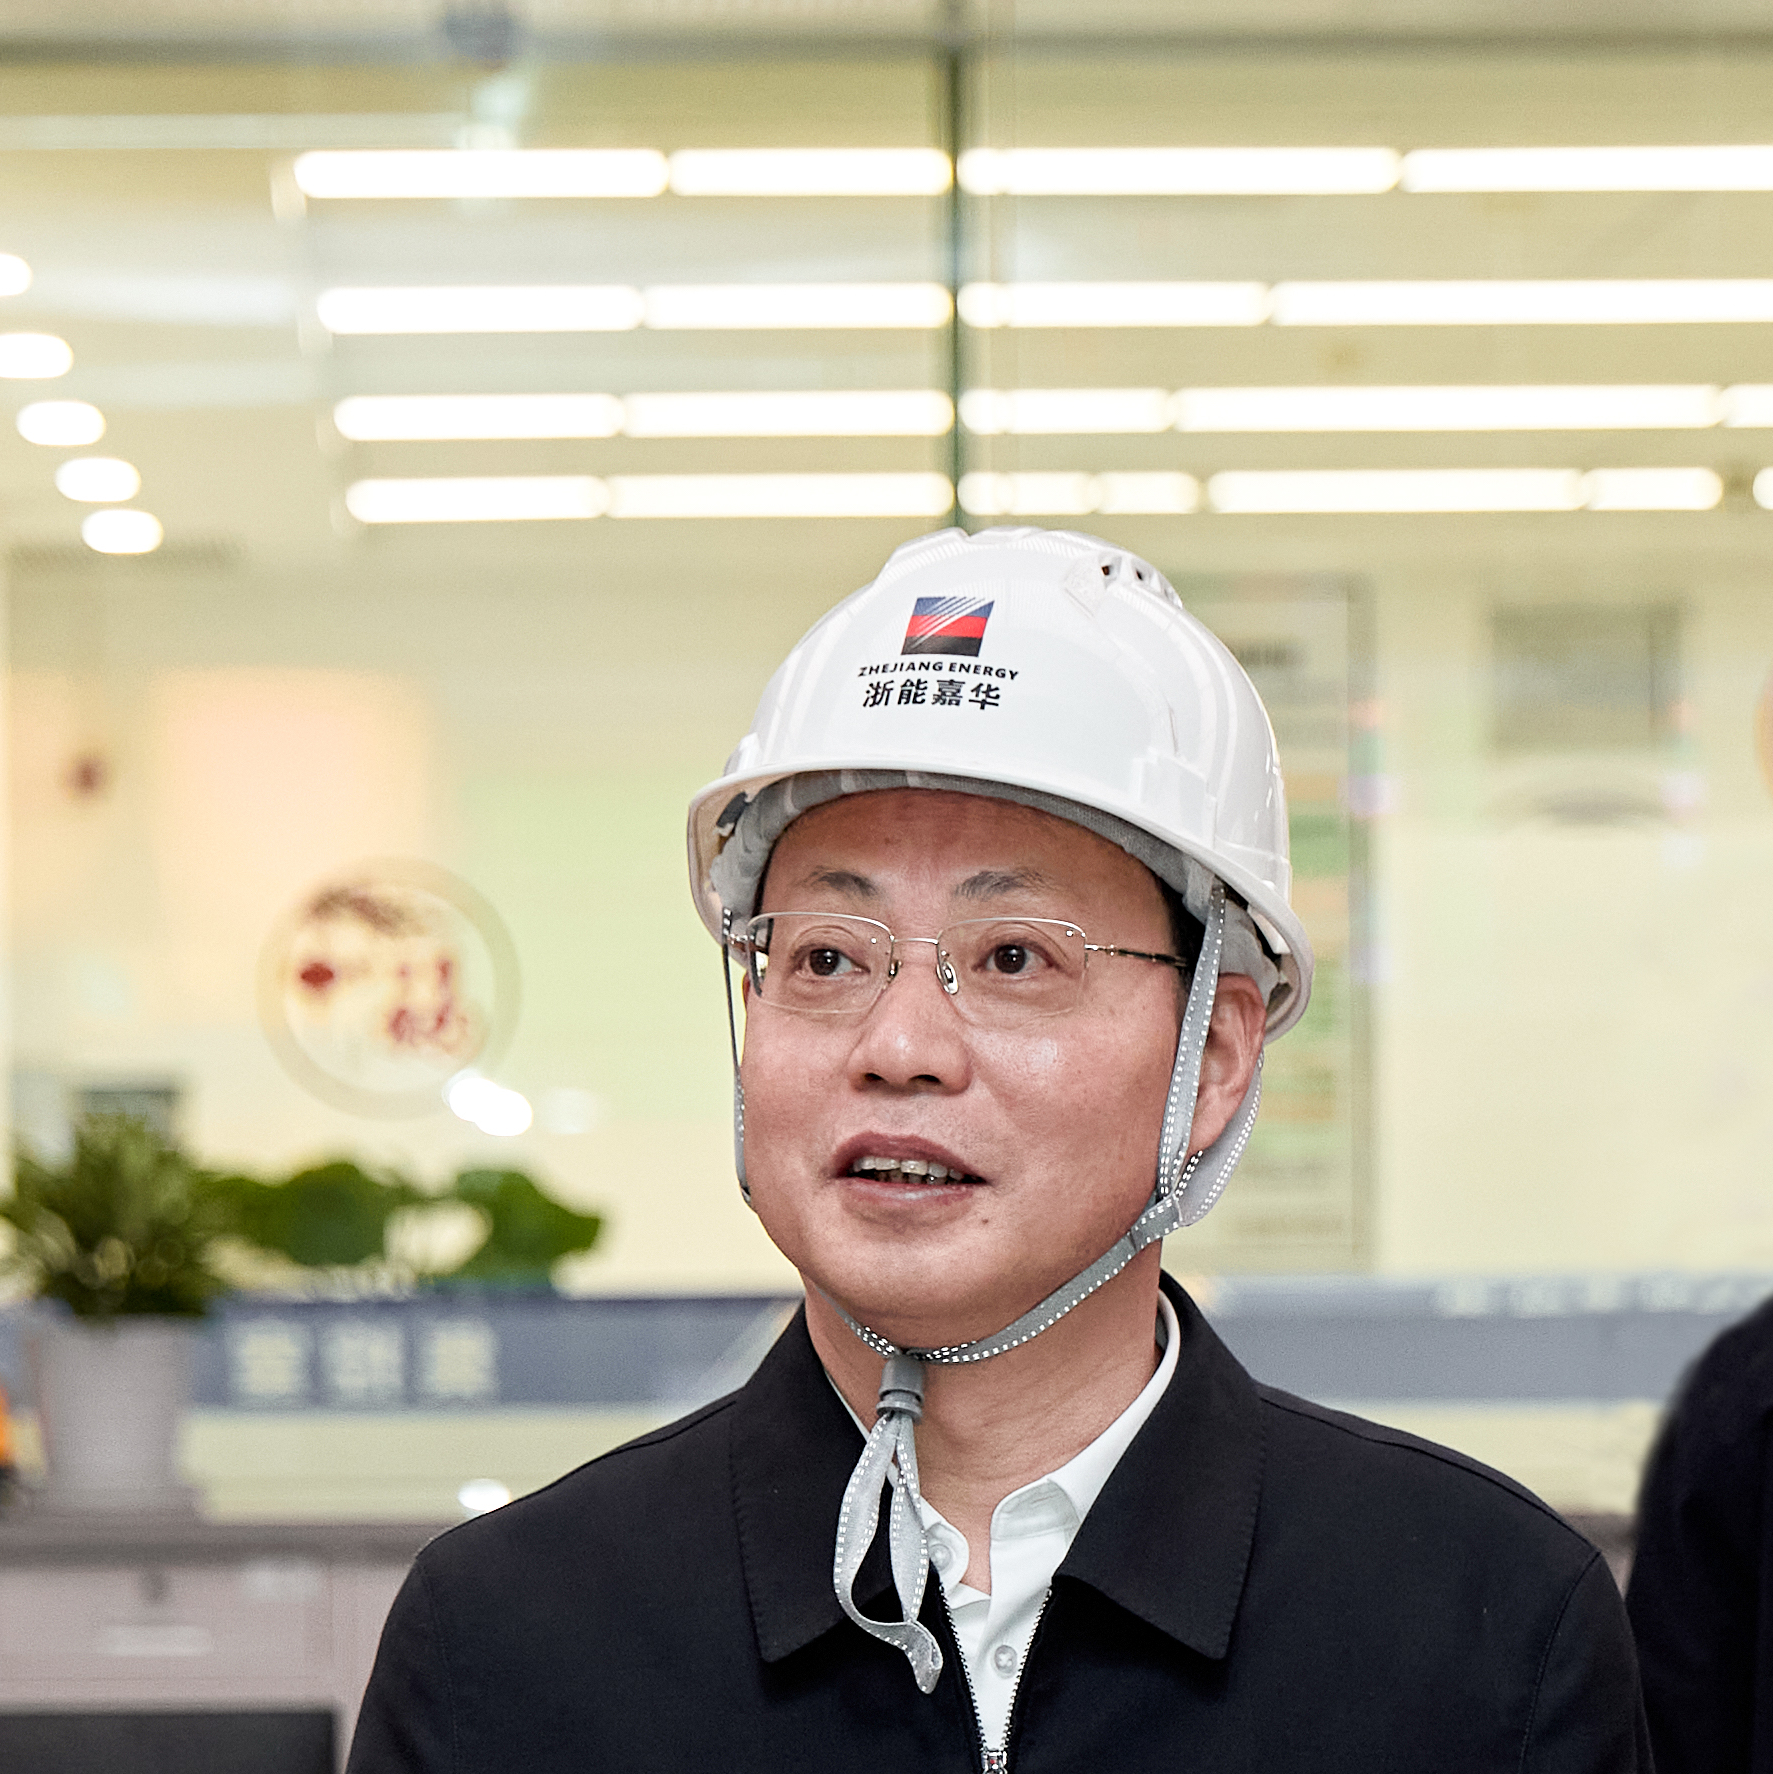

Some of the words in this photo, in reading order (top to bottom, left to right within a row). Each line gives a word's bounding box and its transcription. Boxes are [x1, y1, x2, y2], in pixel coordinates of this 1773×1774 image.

[858, 661, 944, 677] ZHEJIANG
[949, 662, 1019, 680] ENERGY
[863, 678, 1001, 710] 浙能嘉华
